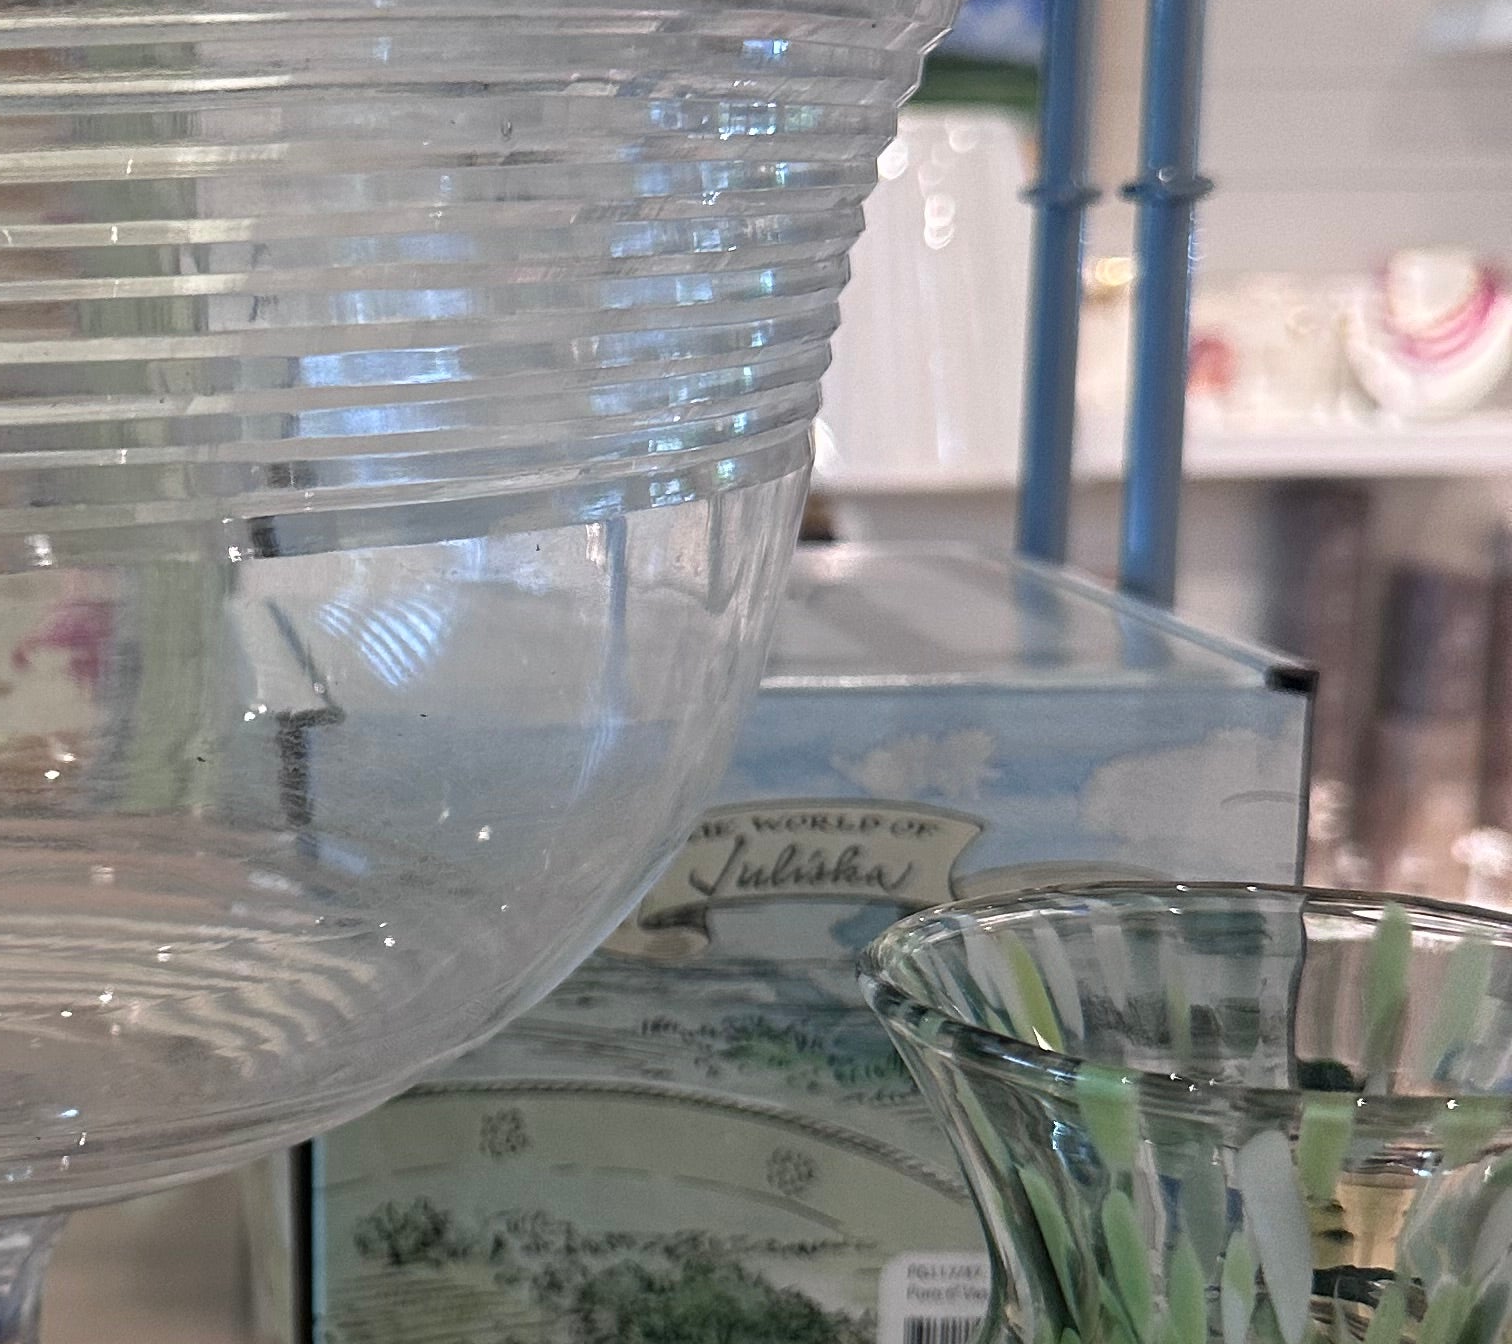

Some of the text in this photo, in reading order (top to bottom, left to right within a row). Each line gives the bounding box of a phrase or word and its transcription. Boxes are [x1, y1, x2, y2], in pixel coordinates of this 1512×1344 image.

[686, 813, 941, 843] HE WORLD OF
[689, 832, 913, 896] Juliska
